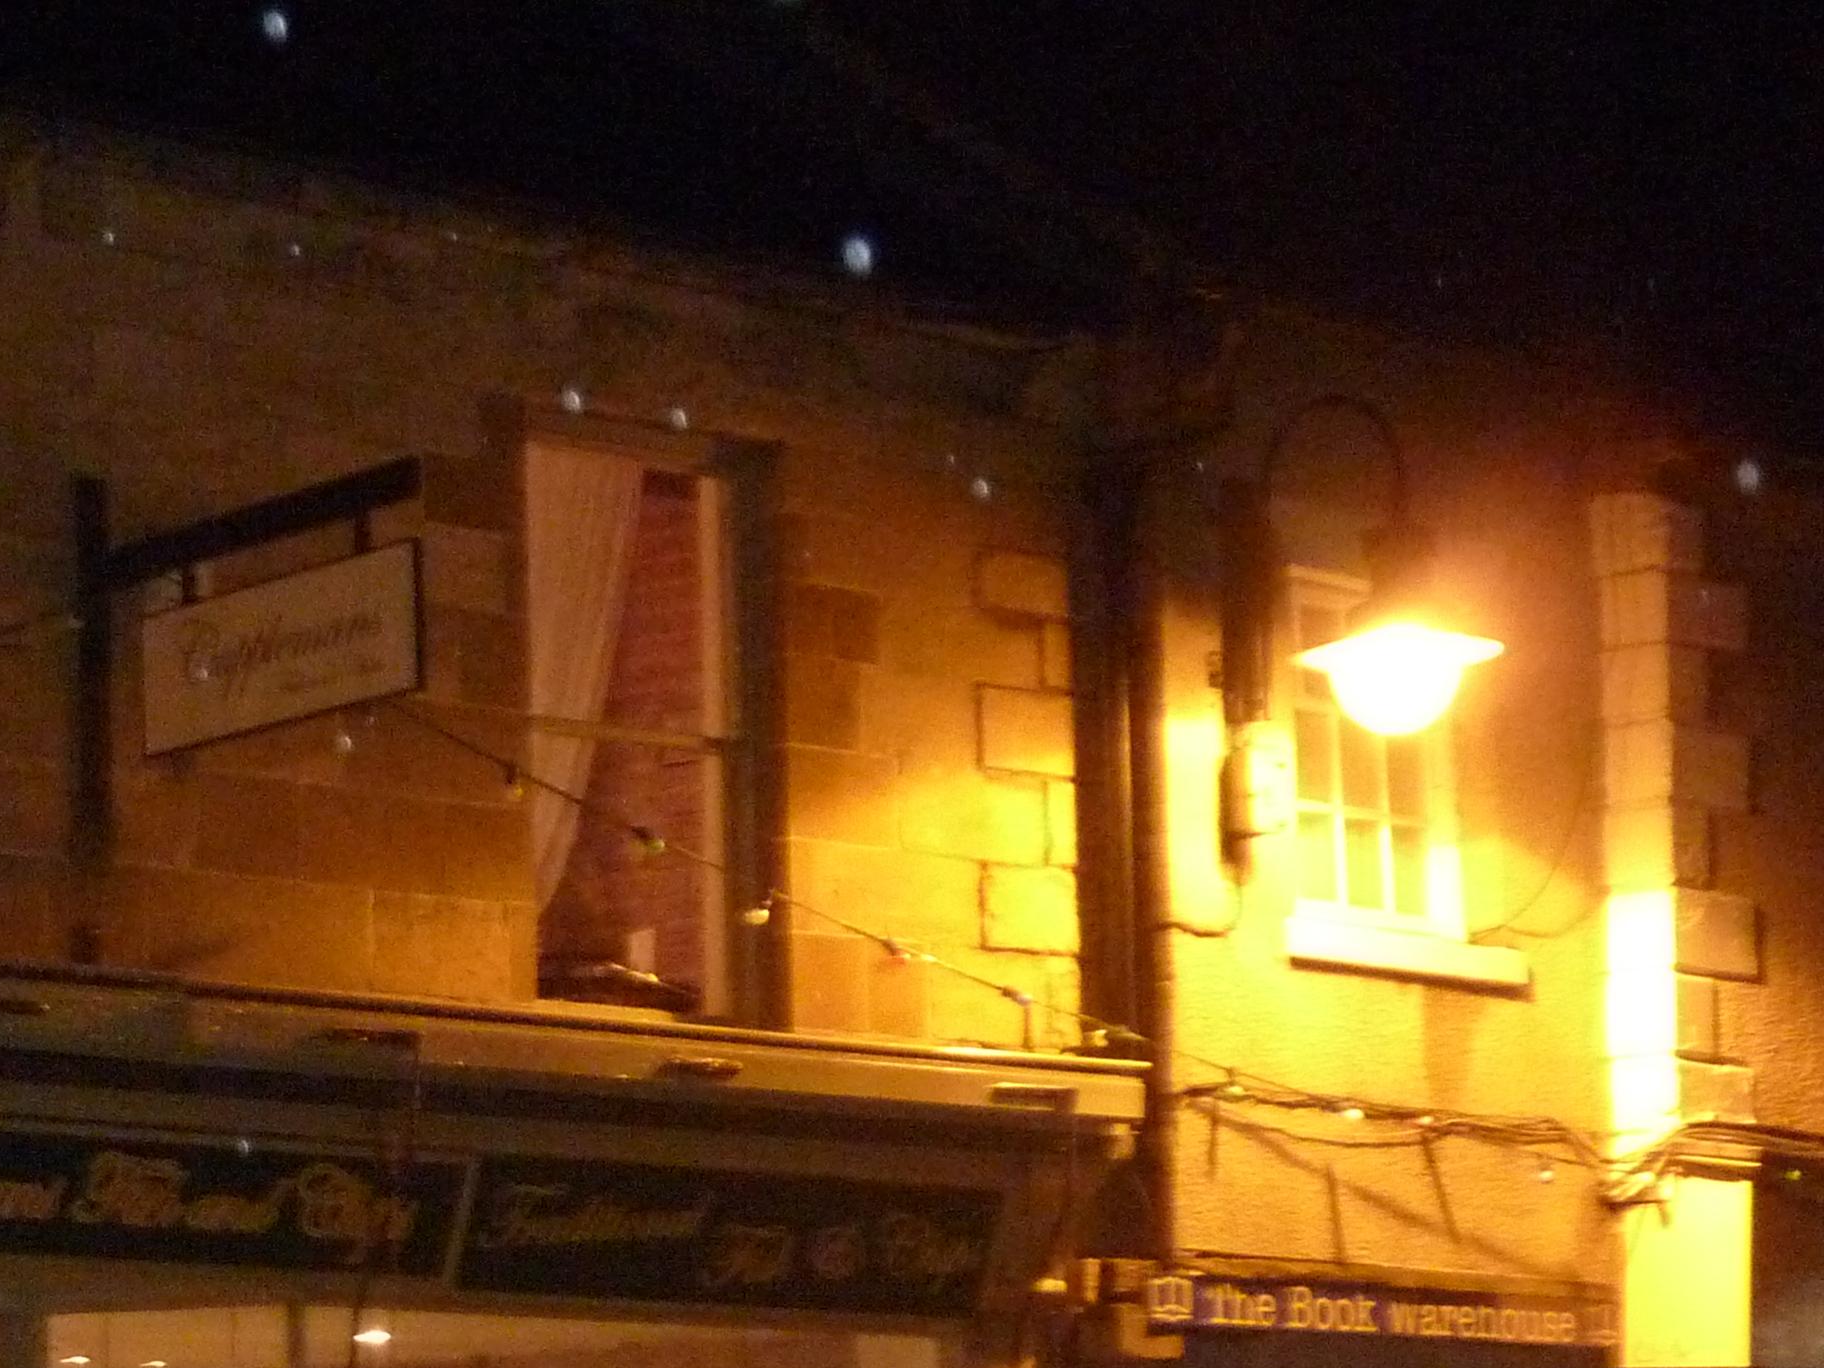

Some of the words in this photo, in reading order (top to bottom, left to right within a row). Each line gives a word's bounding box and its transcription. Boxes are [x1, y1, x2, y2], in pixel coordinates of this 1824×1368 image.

[1204, 1282, 1276, 1327] The
[1282, 1285, 1379, 1333] Book
[1389, 1298, 1577, 1343] warehouse
